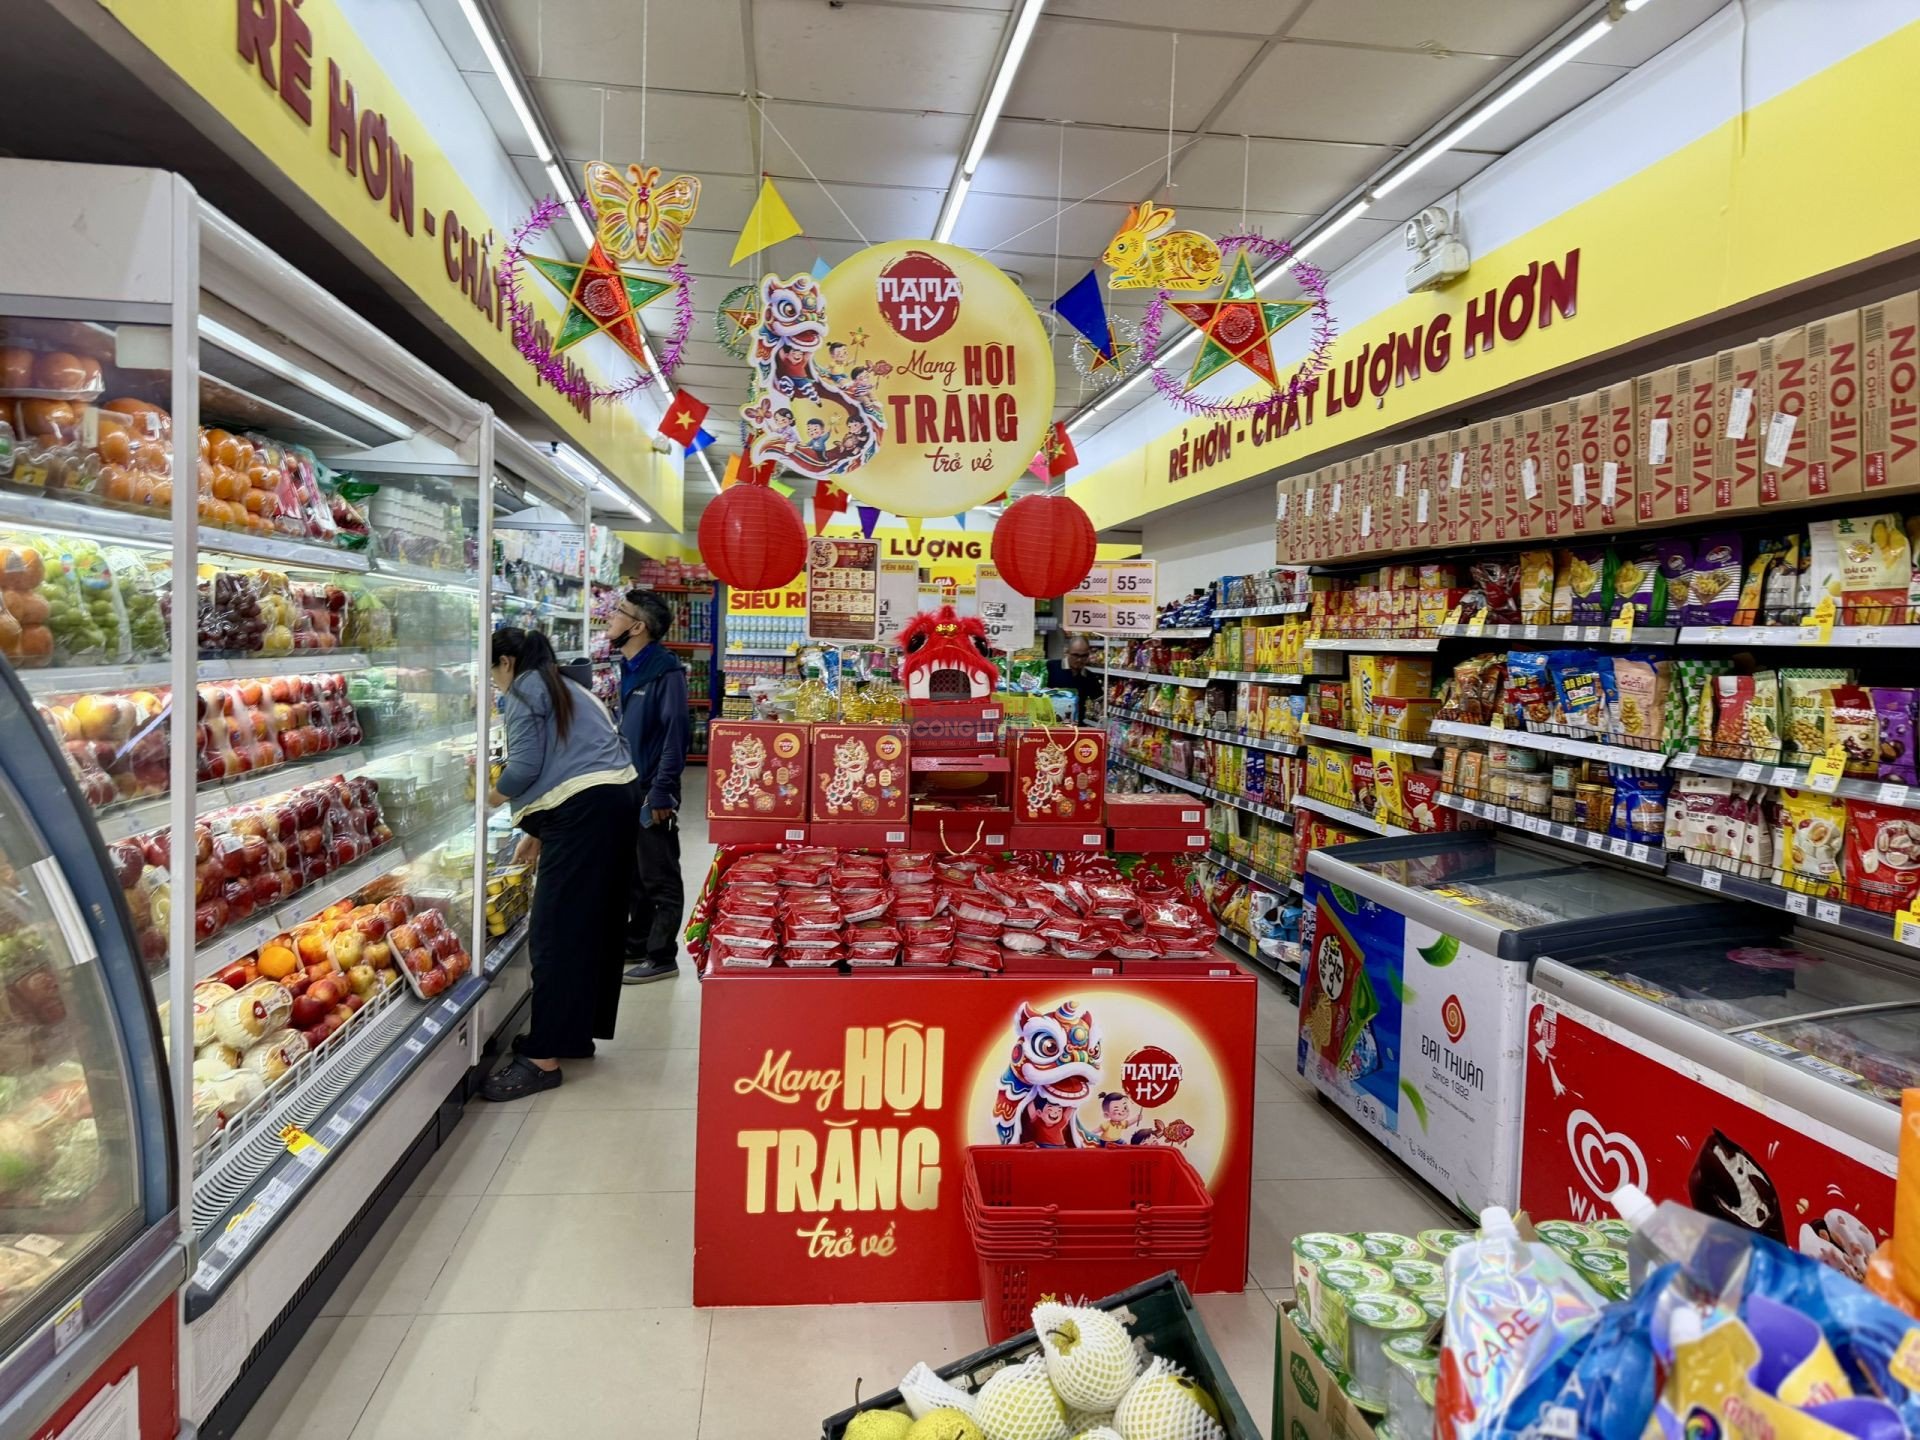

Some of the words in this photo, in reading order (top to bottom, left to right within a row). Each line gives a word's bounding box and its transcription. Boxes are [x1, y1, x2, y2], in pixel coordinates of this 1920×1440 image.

[328, 57, 415, 237] HƠN
[876, 275, 964, 303] MAMA
[899, 304, 945, 332] HY
[897, 349, 957, 386] Mang
[963, 341, 1016, 390] HỘI
[1168, 427, 1190, 484] RẺ
[1191, 420, 1232, 474] HƠN
[1326, 313, 1452, 417] LƯỢNG
[1464, 248, 1581, 360] HƠN
[1888, 324, 1918, 463] VIFON
[888, 388, 1019, 445] TRĂNG
[1655, 394, 1673, 501] VIN
[1692, 382, 1713, 495] VIFON
[1829, 341, 1858, 473] VIFON
[924, 446, 961, 473] trở
[970, 448, 995, 472] về
[1437, 452, 1448, 532] VIFON
[1480, 443, 1493, 528] VIFON
[1503, 437, 1518, 525] VIFON
[1554, 424, 1572, 519] VIFON
[1580, 415, 1601, 513] VIFON
[890, 537, 982, 562] LƯỢNG
[733, 1048, 843, 1112] Mang
[843, 1020, 945, 1117] HỘI
[1120, 1062, 1183, 1082] MAMA
[1135, 1082, 1167, 1101] HY
[1432, 1066, 1450, 1087] Since
[736, 1118, 942, 1214] TRĂNG
[796, 1216, 855, 1259] trở
[860, 1221, 897, 1257] về
[1462, 1308, 1540, 1379] CARE
